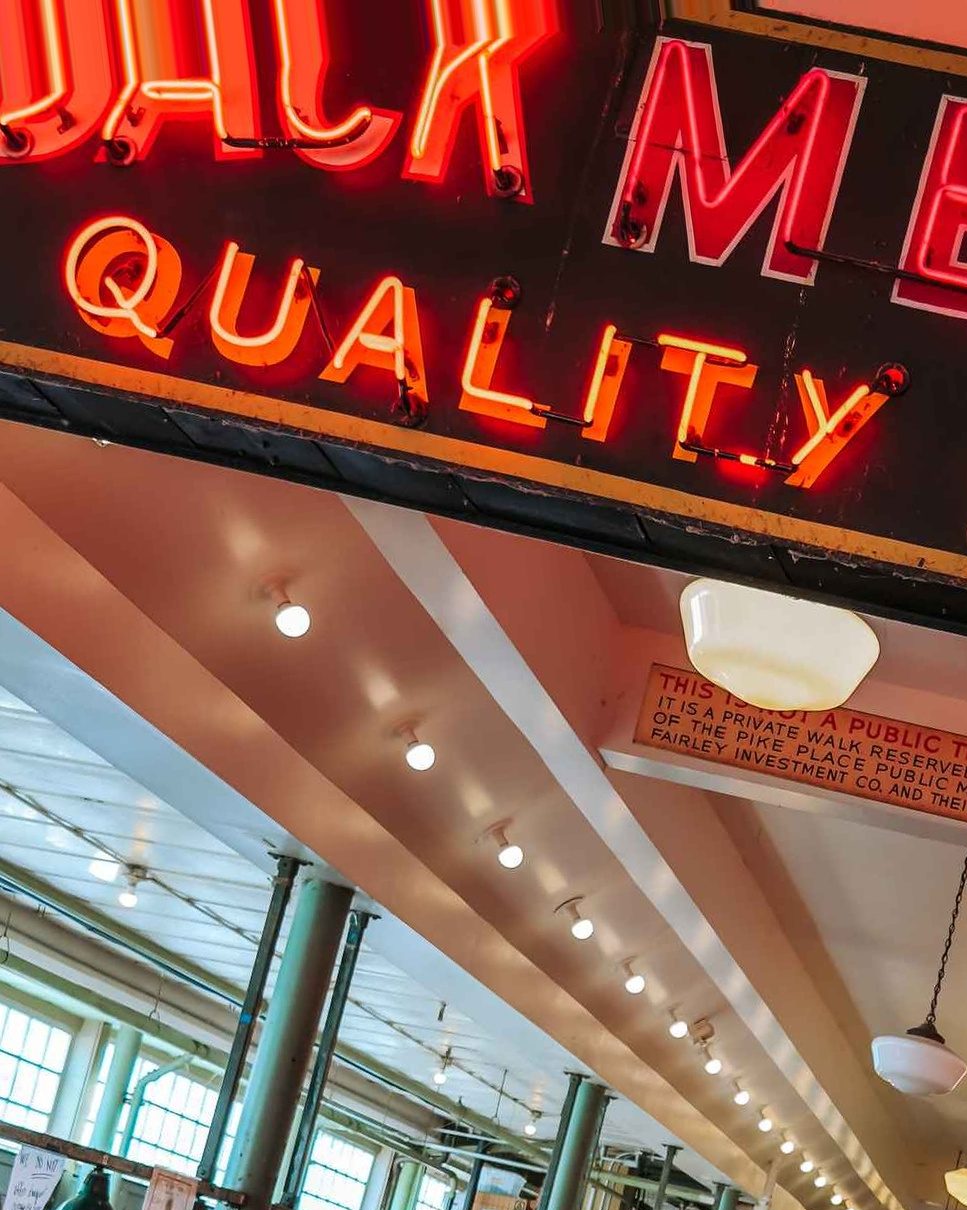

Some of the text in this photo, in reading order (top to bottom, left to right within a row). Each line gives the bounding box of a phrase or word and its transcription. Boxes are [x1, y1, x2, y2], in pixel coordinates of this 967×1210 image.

[65, 216, 893, 489] QUALITY
[653, 712, 681, 727] OF
[691, 719, 726, 740] THE
[736, 731, 785, 753] PIKE
[796, 744, 867, 773] PLACE
[876, 762, 949, 791] PUBLIC
[658, 696, 671, 711] IT
[681, 700, 697, 716] IS
[703, 707, 714, 721] A
[722, 711, 799, 739] PRIVATE
[807, 730, 862, 754] WALK
[660, 673, 714, 699] THIS
[820, 711, 838, 731] A
[849, 717, 942, 755] PUBLIC
[651, 728, 728, 755] FAIRLEY
[734, 748, 849, 784] INVESTMENT
[856, 775, 883, 794] CO.
[889, 783, 923, 802] AND
